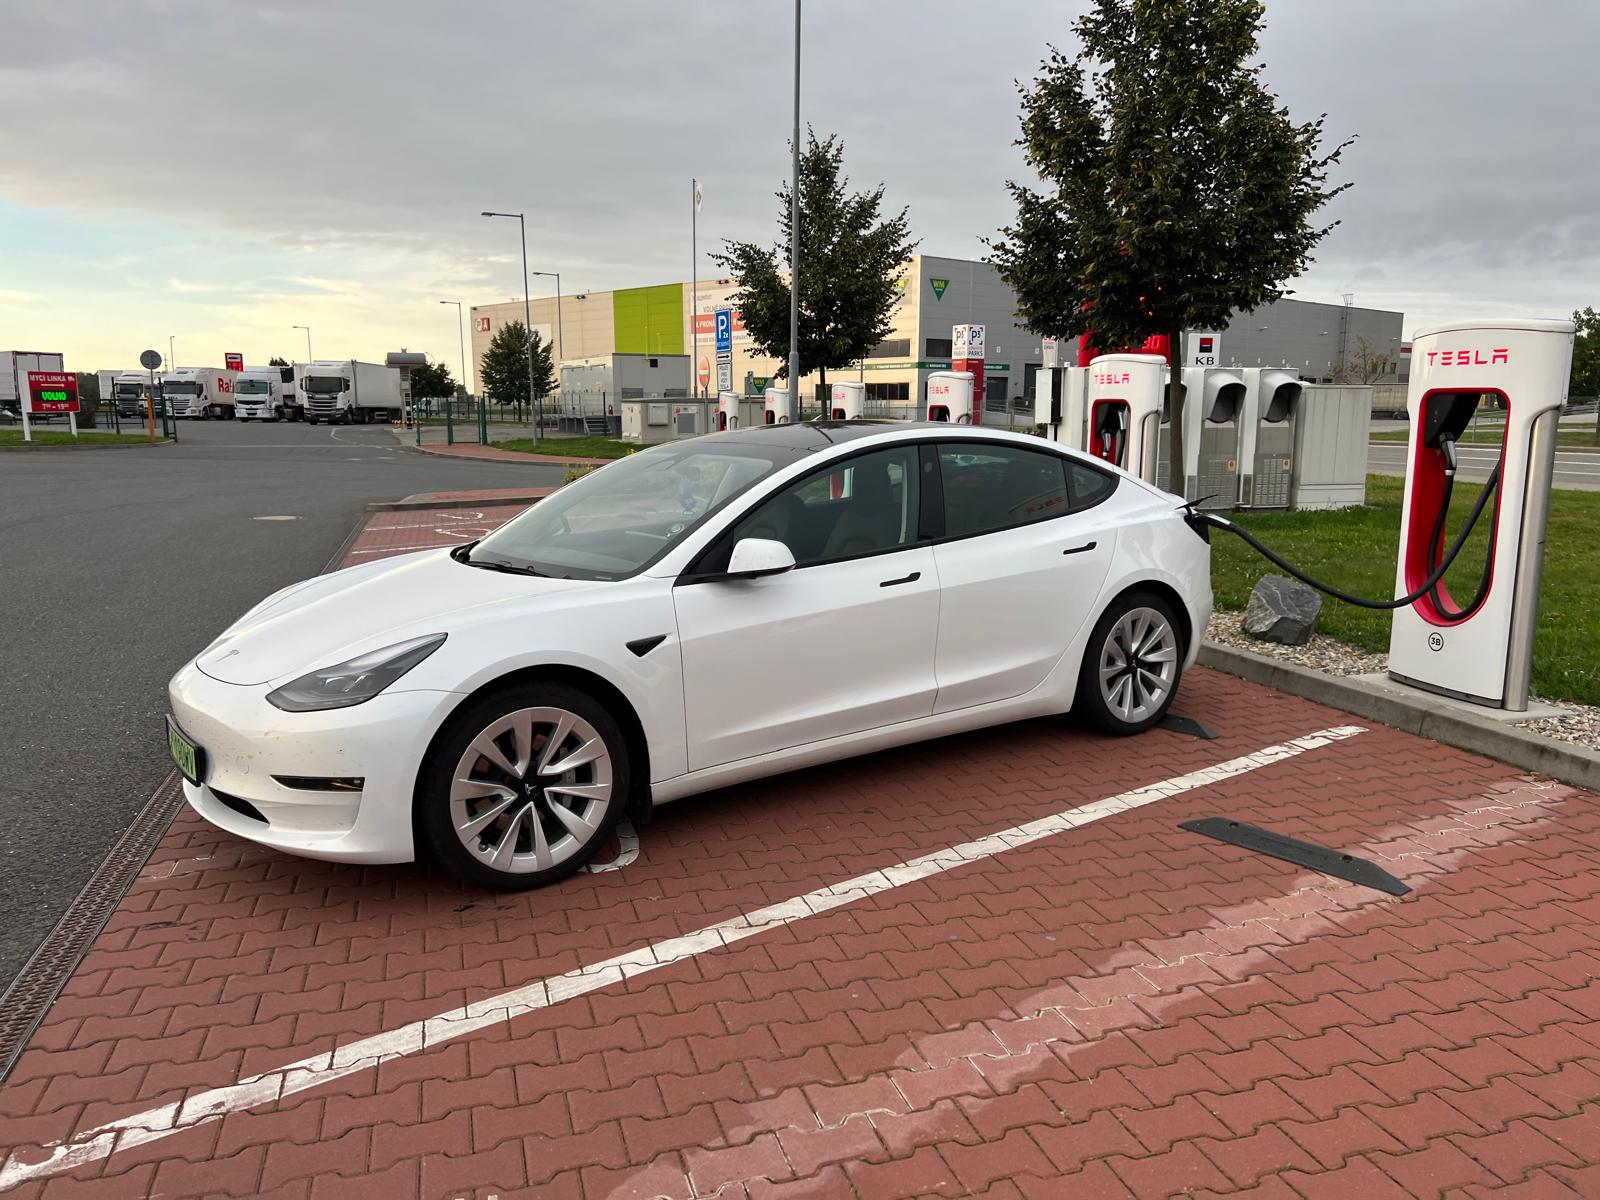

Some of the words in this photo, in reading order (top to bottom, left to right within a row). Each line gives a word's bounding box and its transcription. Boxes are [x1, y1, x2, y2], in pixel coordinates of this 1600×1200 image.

[1195, 357, 1215, 365] KB
[1427, 349, 1508, 366] TESLA
[1094, 373, 1130, 384] TESLA
[1431, 637, 1441, 645] 3B
